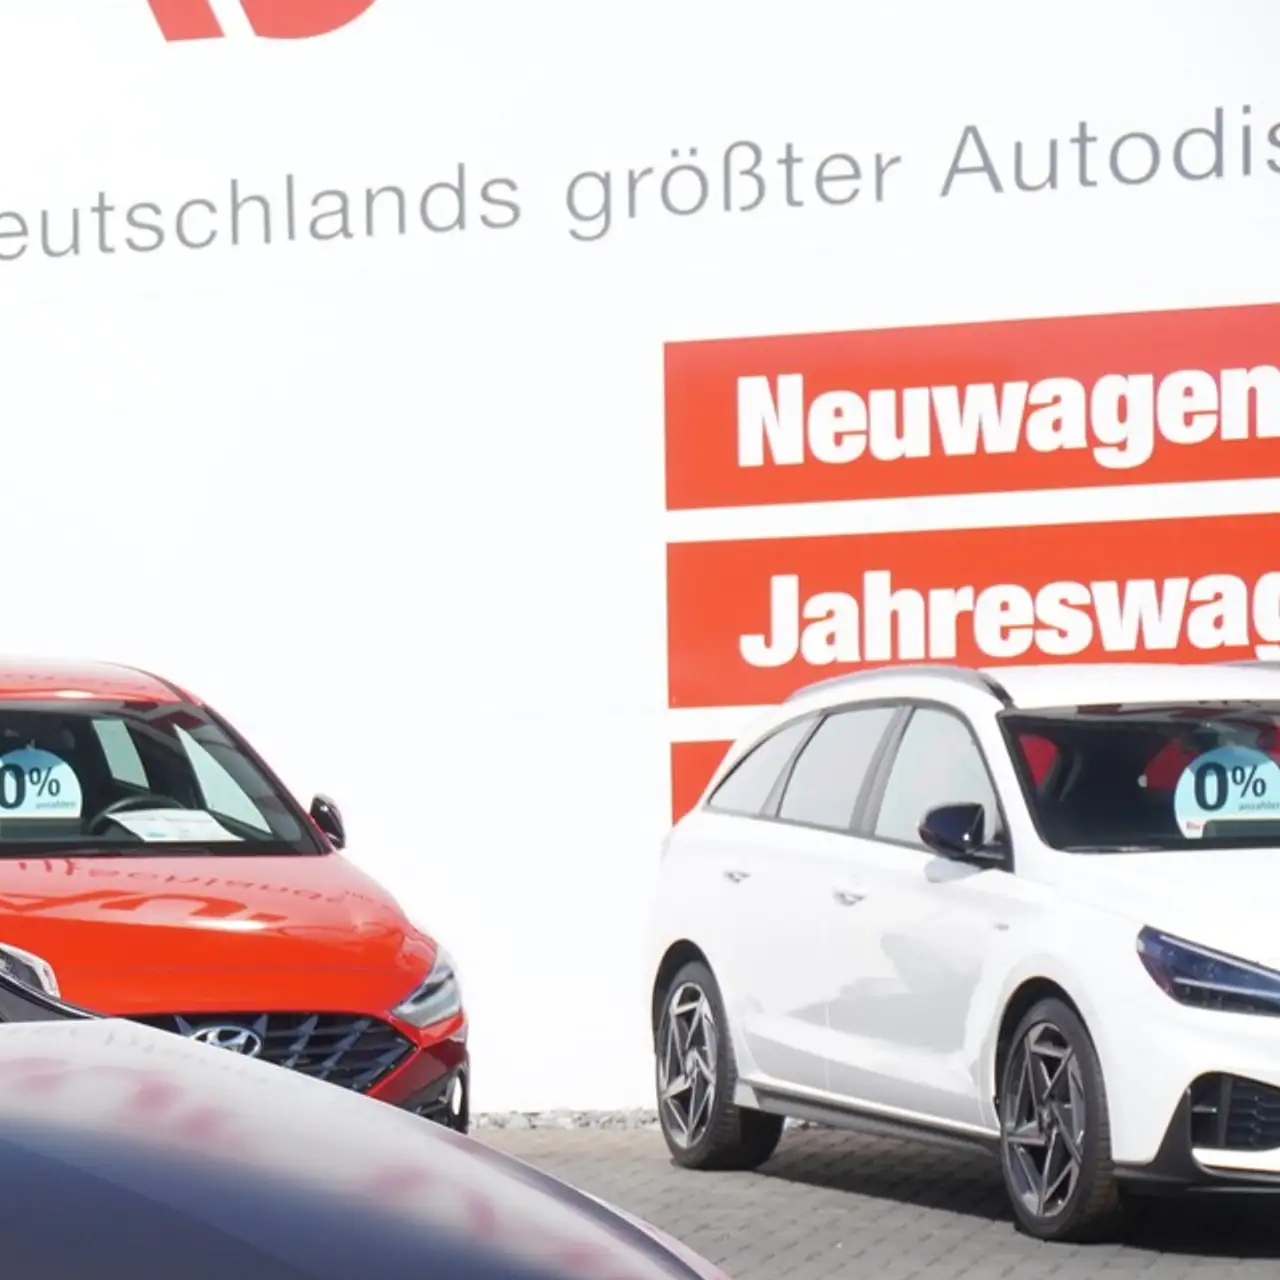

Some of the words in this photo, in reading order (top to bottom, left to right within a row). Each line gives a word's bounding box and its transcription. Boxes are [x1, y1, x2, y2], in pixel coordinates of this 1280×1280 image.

[566, 140, 902, 242] größter
[737, 364, 1280, 470] Neuwagen
[1194, 761, 1267, 812] 0%
